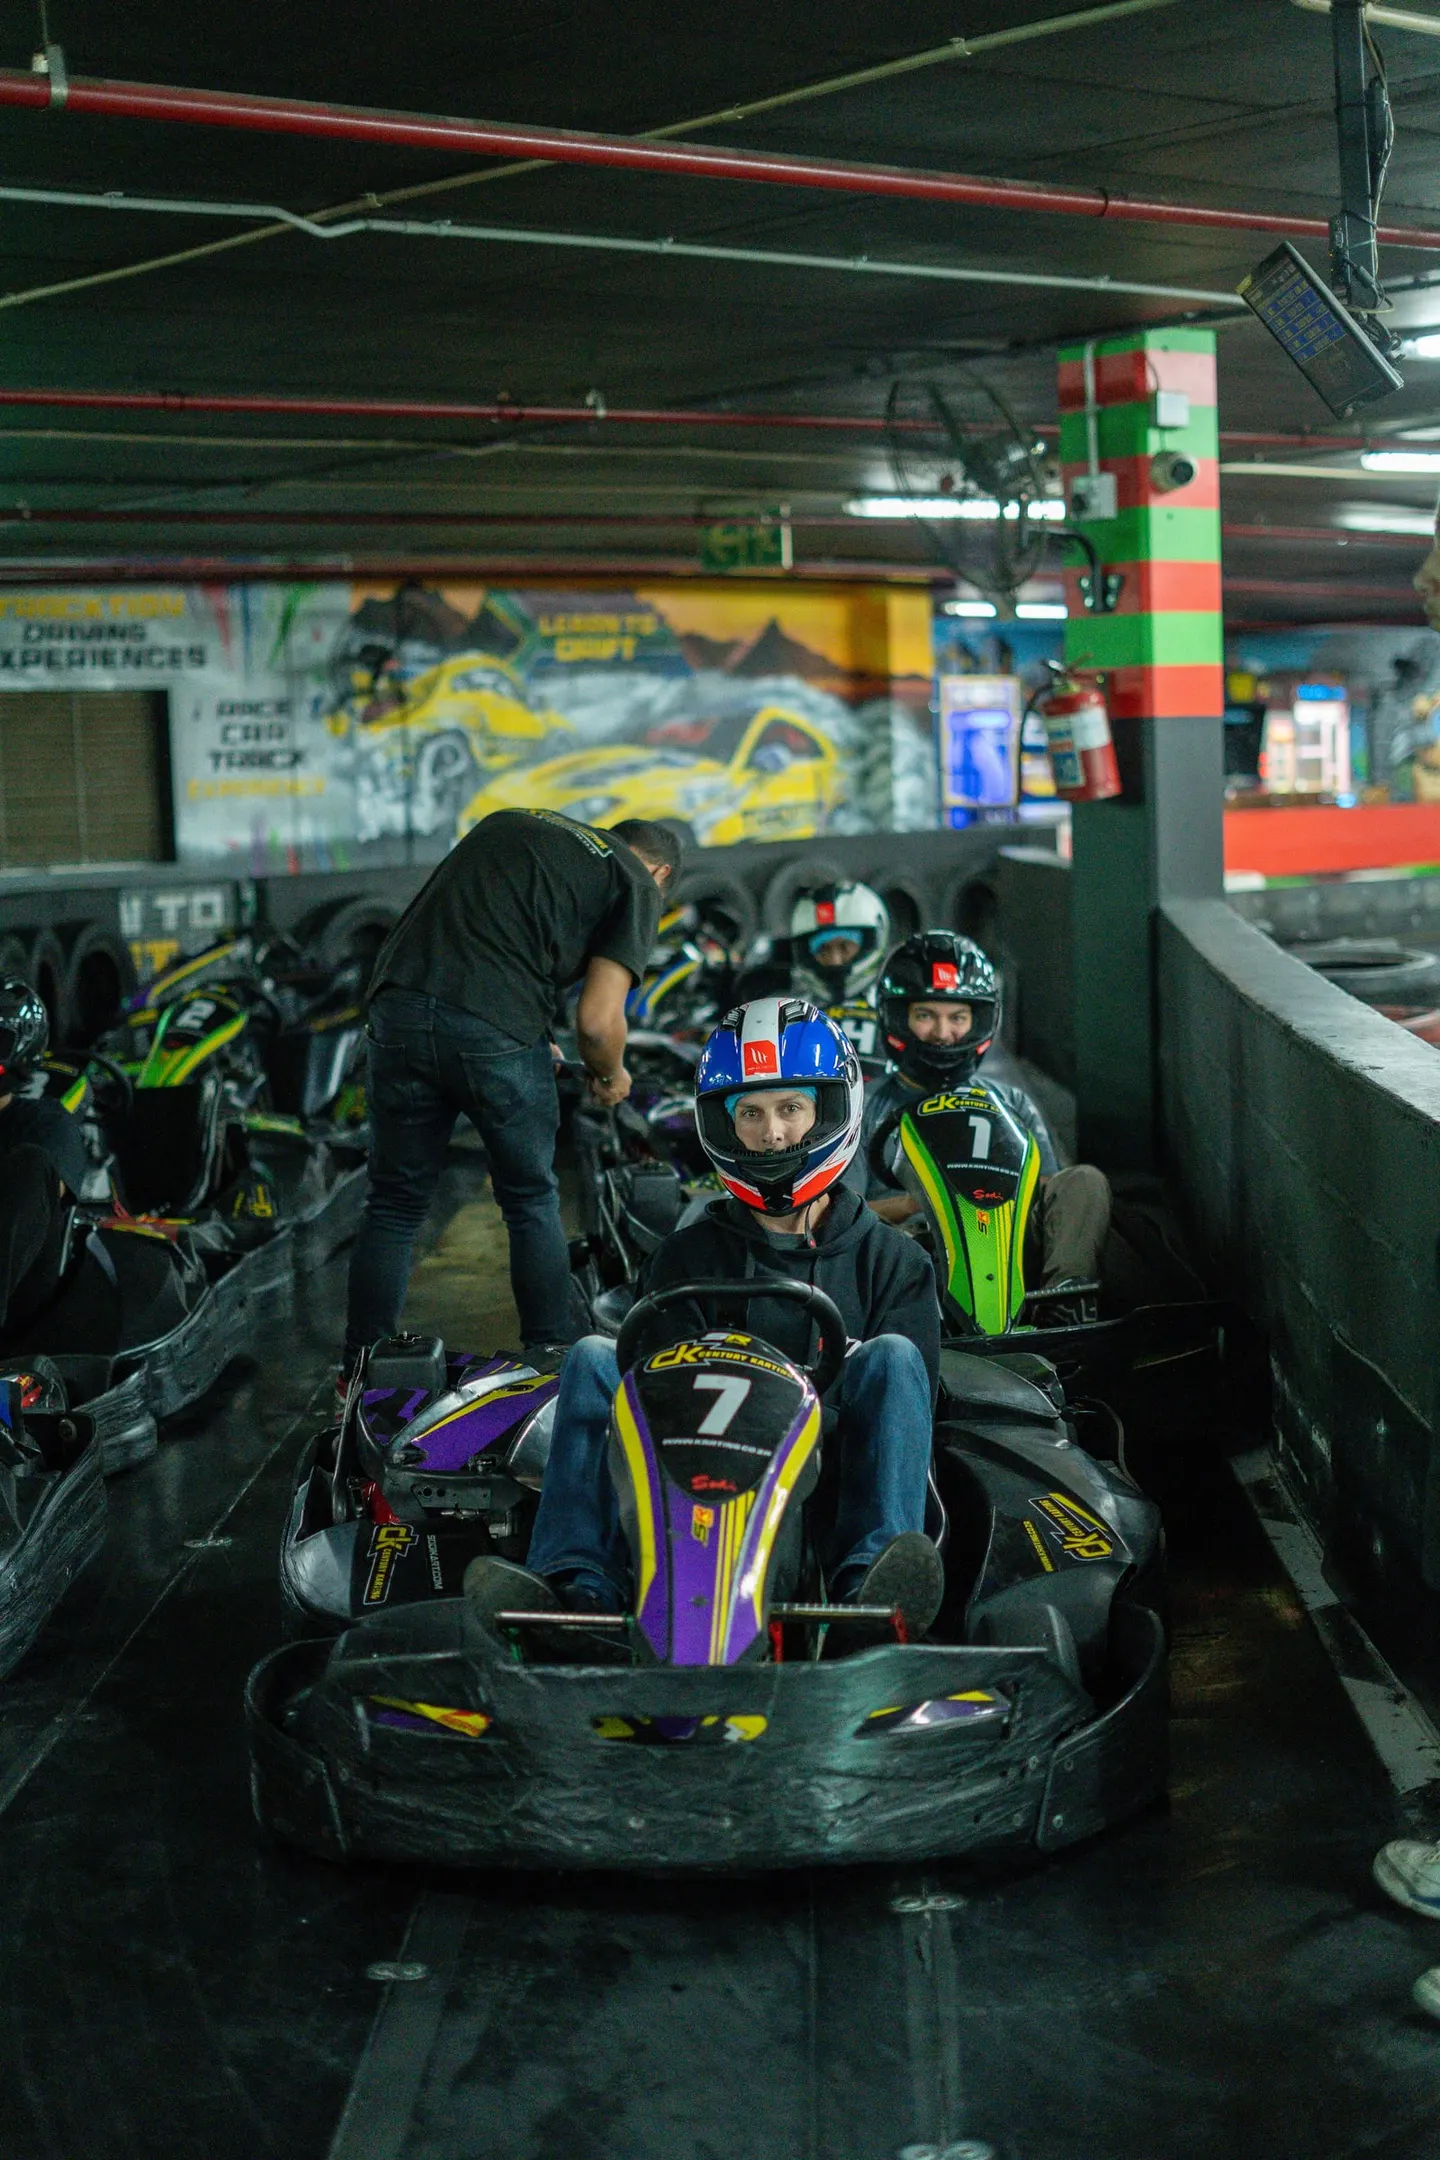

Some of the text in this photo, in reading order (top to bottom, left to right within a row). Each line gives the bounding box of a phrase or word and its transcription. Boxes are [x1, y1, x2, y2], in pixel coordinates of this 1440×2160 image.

[24, 622, 147, 642] DRIVING
[221, 723, 285, 743] CAR
[176, 1000, 216, 1029] 2
[922, 1095, 957, 1113] CK
[968, 1115, 992, 1159] 1
[651, 1344, 704, 1369] CK
[698, 1351, 749, 1362] CENTURY
[693, 1373, 751, 1435] 7
[376, 1527, 411, 1549] CK
[380, 1548, 391, 1571] CENTURY
